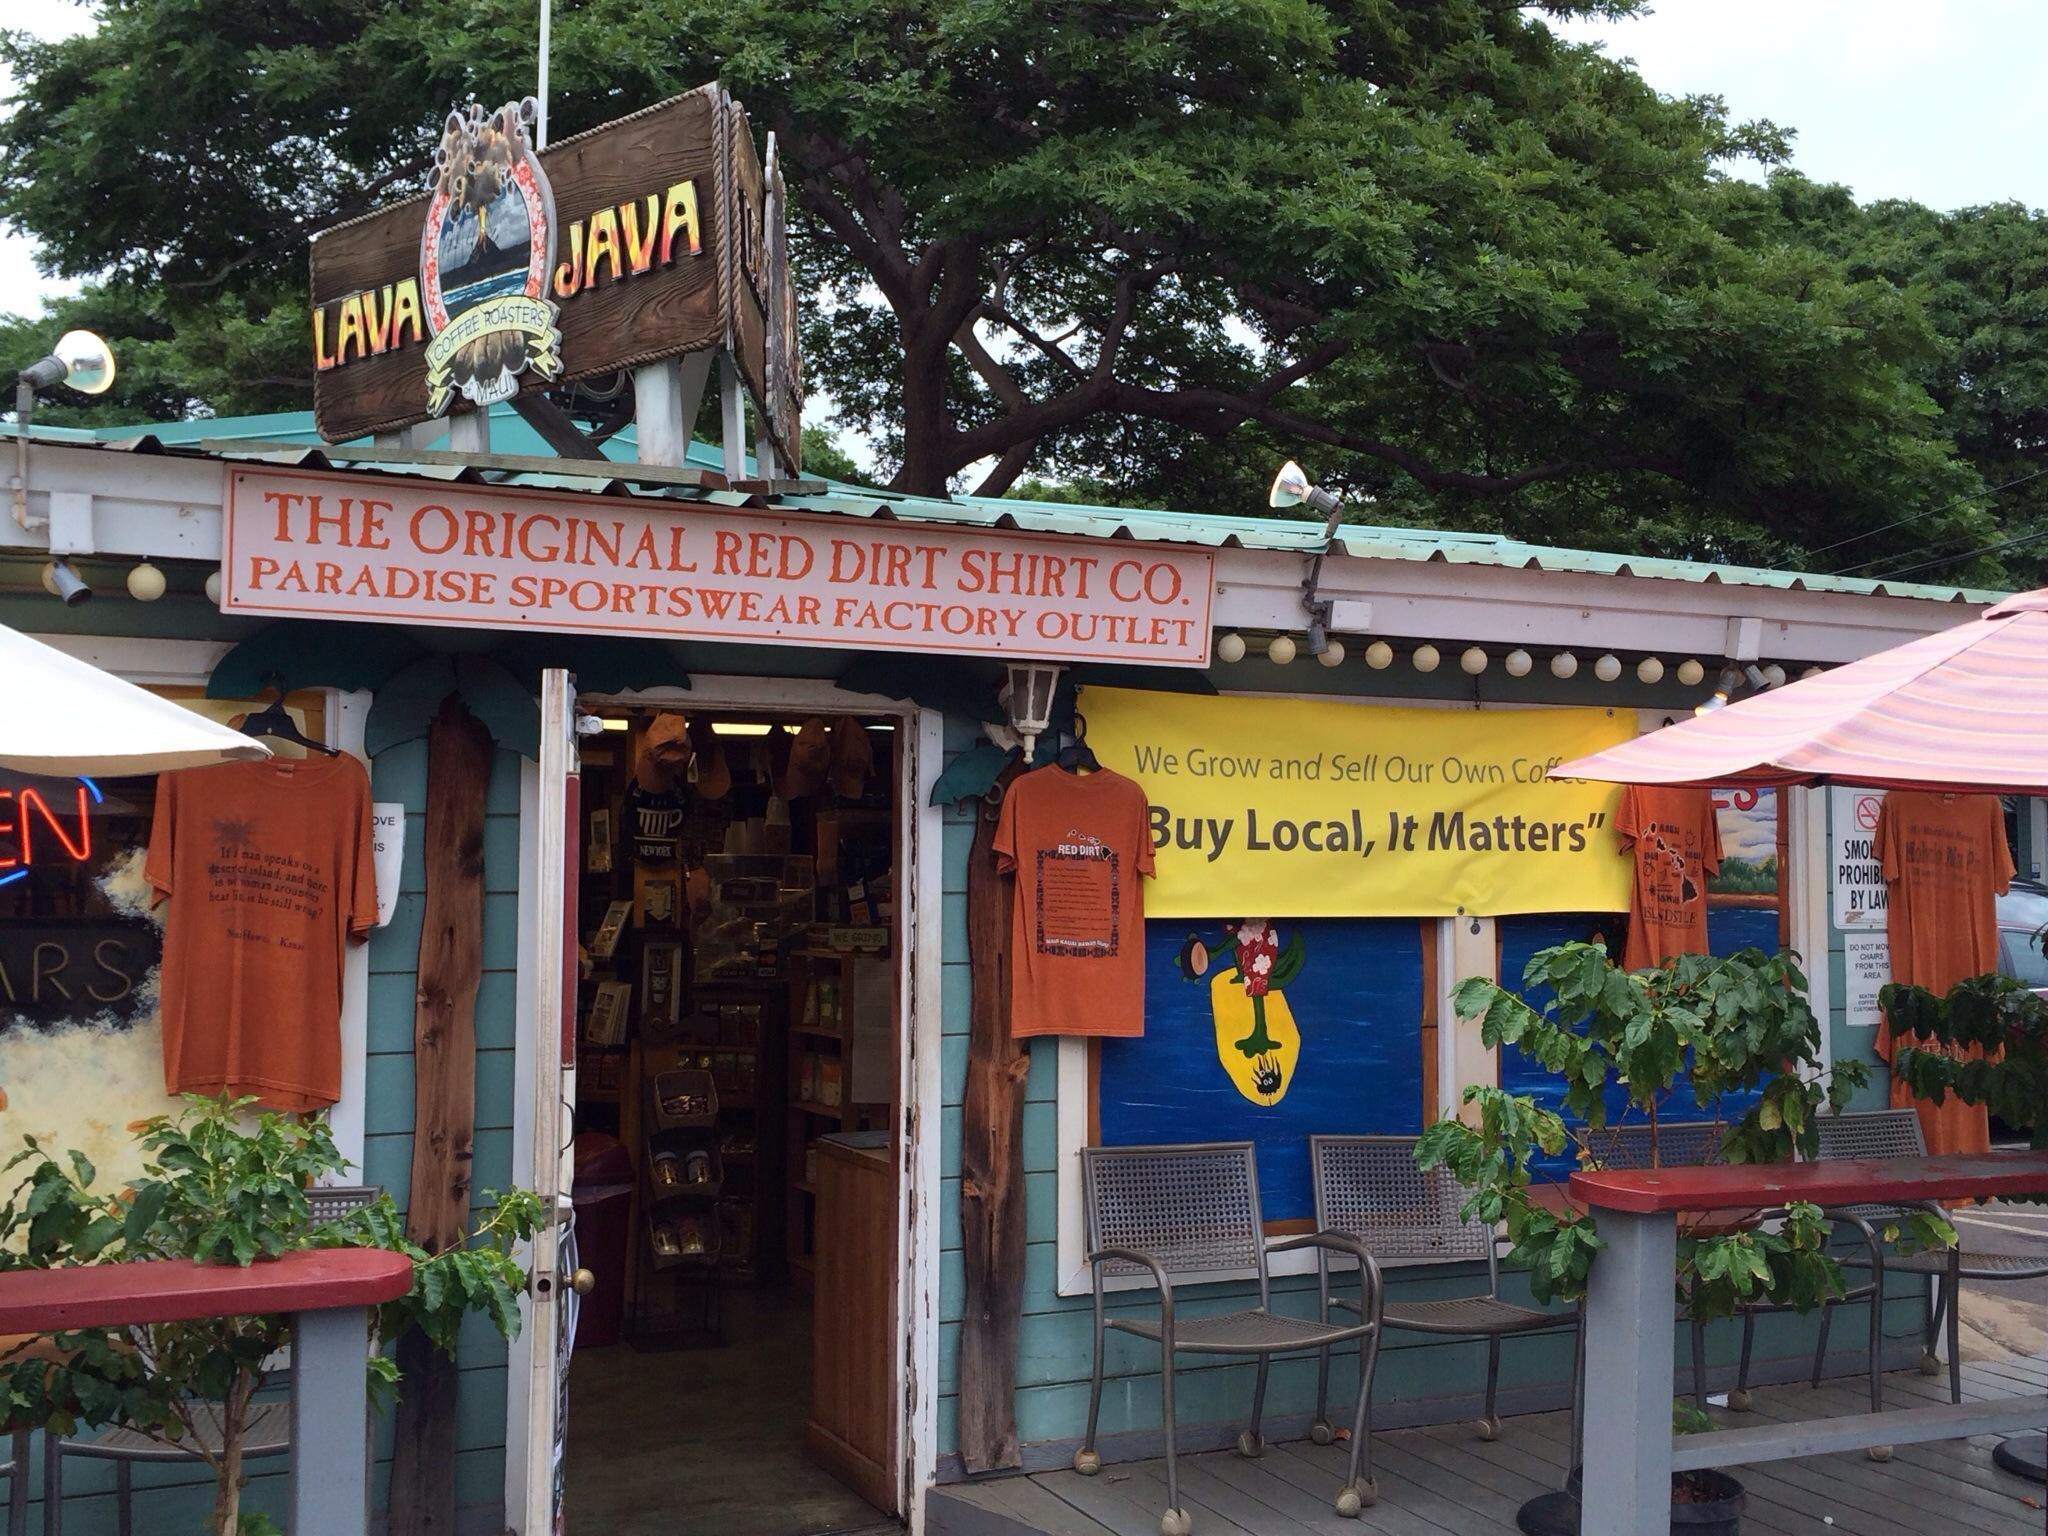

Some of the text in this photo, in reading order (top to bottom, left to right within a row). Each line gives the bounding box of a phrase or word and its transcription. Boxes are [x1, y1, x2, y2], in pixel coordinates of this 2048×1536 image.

[314, 180, 702, 371] LAVA JAVA
[434, 305, 544, 361] COFFEE ROASTERS
[475, 372, 512, 403] MAUI
[264, 492, 1190, 607] THE ORIGINAL RED DIRT SHIRT CO.
[248, 556, 1195, 647] PARADISE SPORTSWEAR FACTORY OUTLET
[1134, 745, 1178, 775] We
[1186, 748, 1261, 778] Grow
[1269, 753, 1323, 780] and
[1330, 754, 1378, 782] Sell
[1384, 756, 1434, 783] Our
[1442, 757, 1505, 783] Own
[1147, 806, 1234, 863] Buy
[1247, 808, 1376, 858] Local,
[1388, 811, 1419, 851] It
[1058, 844, 1101, 857] RED DIRT
[1851, 890, 1889, 909] BY LAW
[1849, 943, 1890, 952] DO NOT MOV
[1860, 953, 1884, 961] CHAIRS
[1855, 962, 1890, 970] FROM THIS
[1863, 971, 1881, 979] AREA
